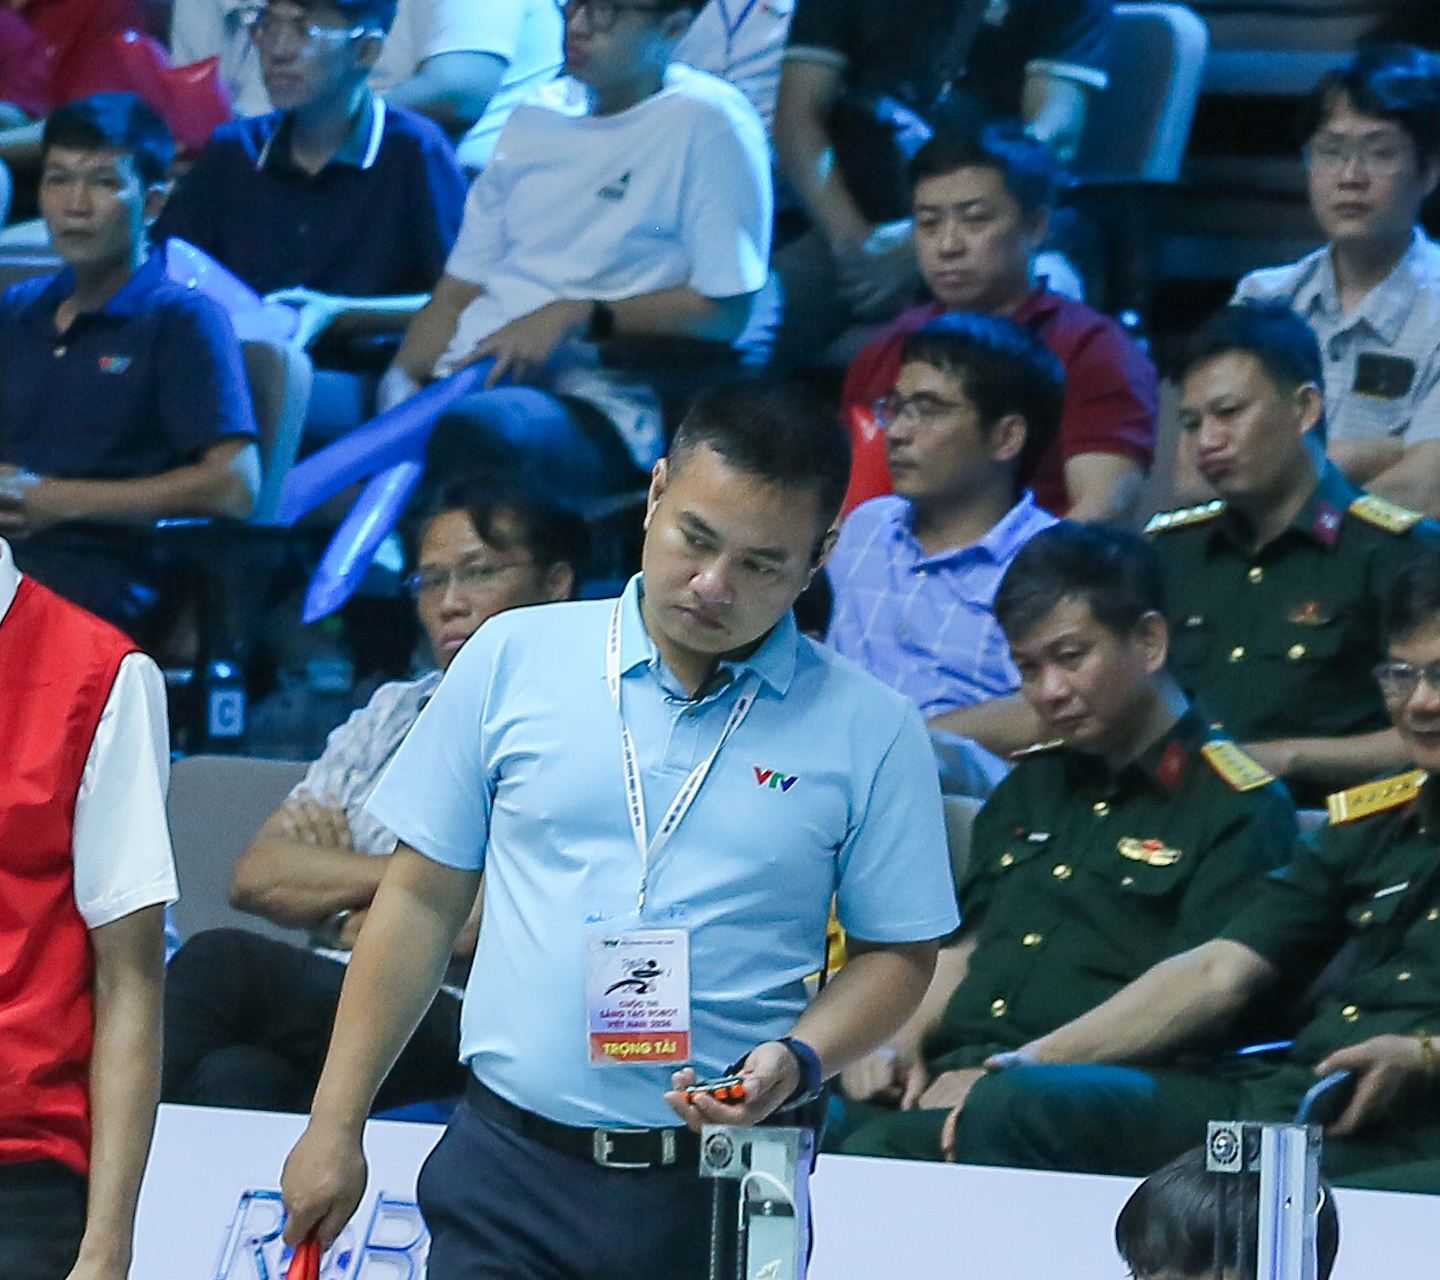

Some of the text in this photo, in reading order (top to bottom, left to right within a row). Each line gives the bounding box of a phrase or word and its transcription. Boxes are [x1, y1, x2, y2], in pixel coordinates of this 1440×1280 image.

[752, 765, 801, 794] VTV
[602, 1038, 678, 1059] TRỌNG TÀI
